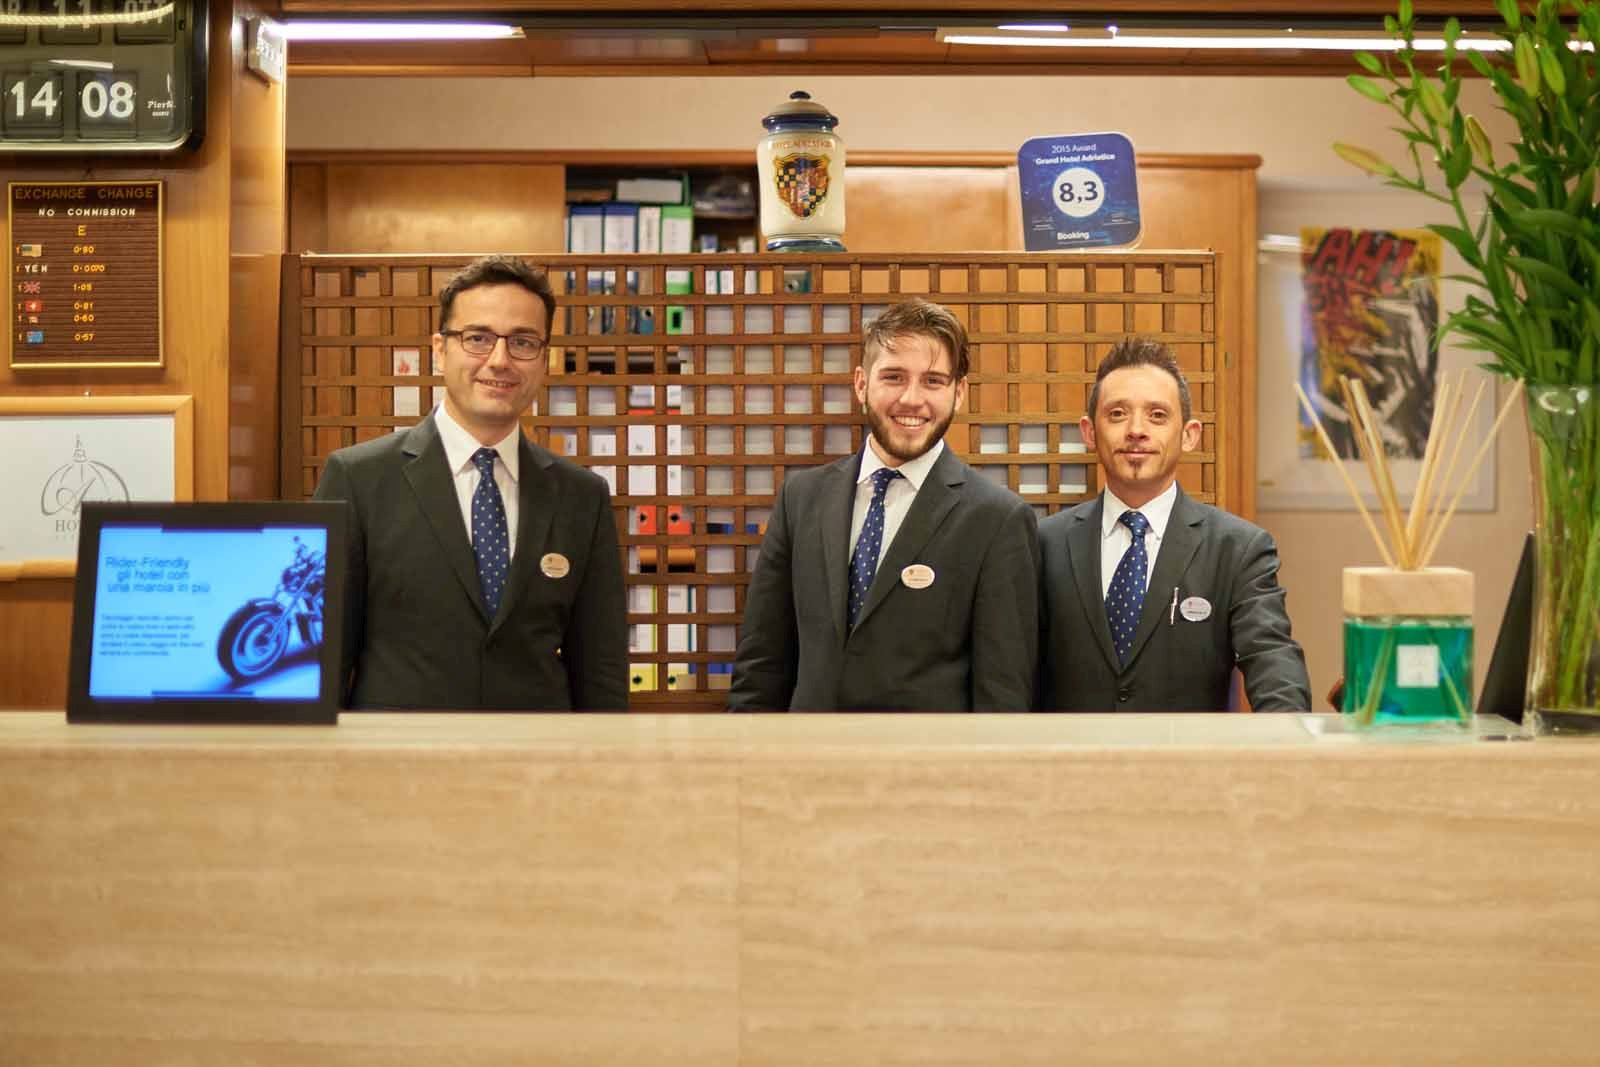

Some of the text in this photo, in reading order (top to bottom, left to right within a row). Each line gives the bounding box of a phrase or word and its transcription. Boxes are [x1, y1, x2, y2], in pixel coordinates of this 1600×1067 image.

[123, 0, 167, 25] OTT
[10, 80, 135, 118] 14 08
[1052, 143, 1097, 154] 2015 Award
[1035, 157, 1059, 166] Grand
[1060, 155, 1081, 164] Hotel
[15, 187, 154, 200] EXCHANGE CHANGE
[1059, 181, 1099, 204] 8,3
[38, 208, 136, 217] NO COMMISSION
[24, 265, 48, 273] YEN
[55, 519, 81, 533] HO
[134, 569, 164, 580] hotel
[167, 571, 190, 580] con
[107, 583, 130, 593] una
[133, 583, 174, 593] marcia
